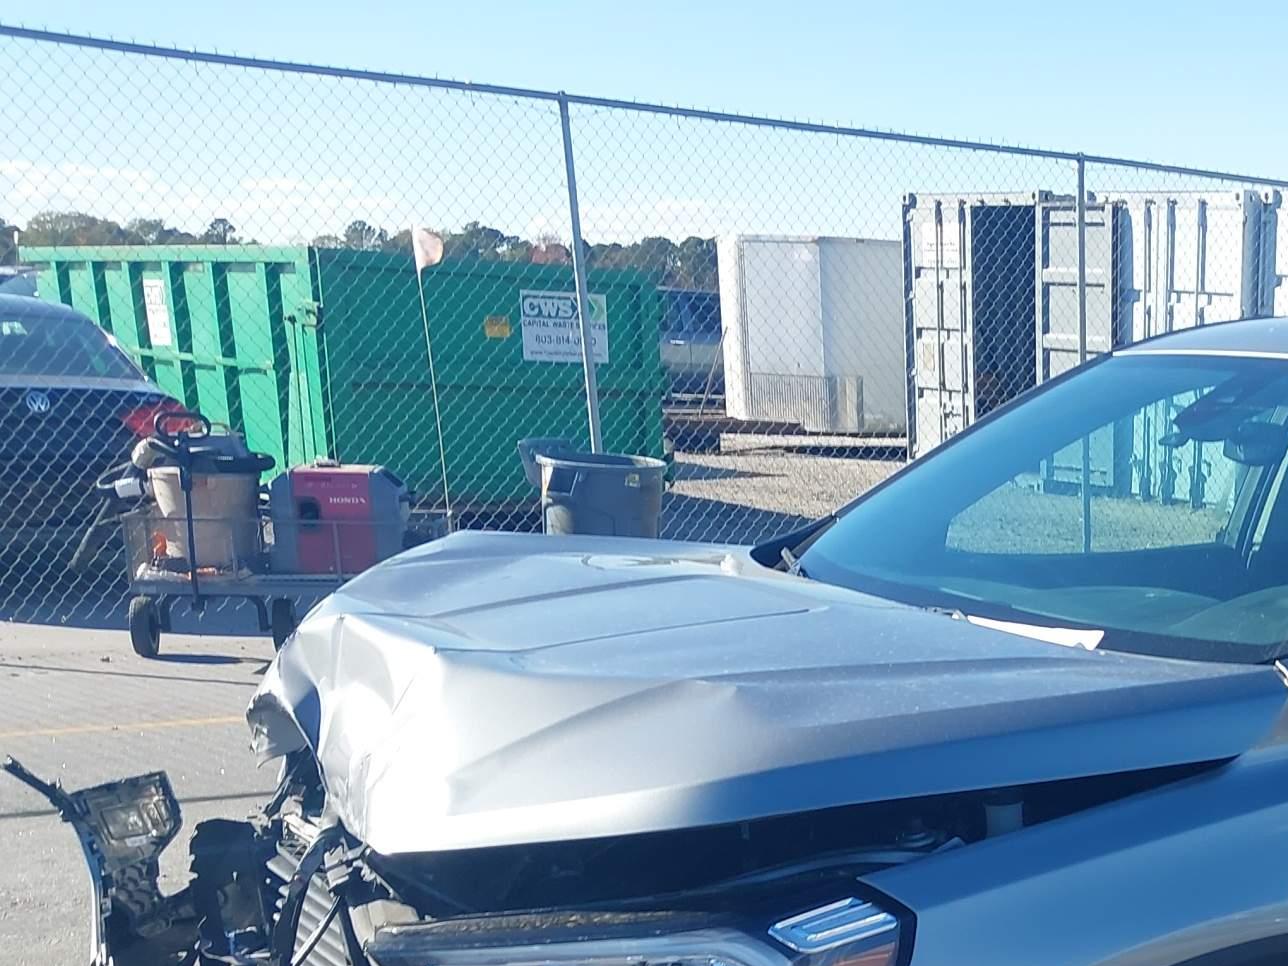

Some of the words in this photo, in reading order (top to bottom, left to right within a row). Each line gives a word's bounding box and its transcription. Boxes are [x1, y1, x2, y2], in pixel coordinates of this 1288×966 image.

[523, 297, 573, 317] CWS
[523, 319, 549, 328] CAPITAL
[329, 496, 366, 504] HONDA
